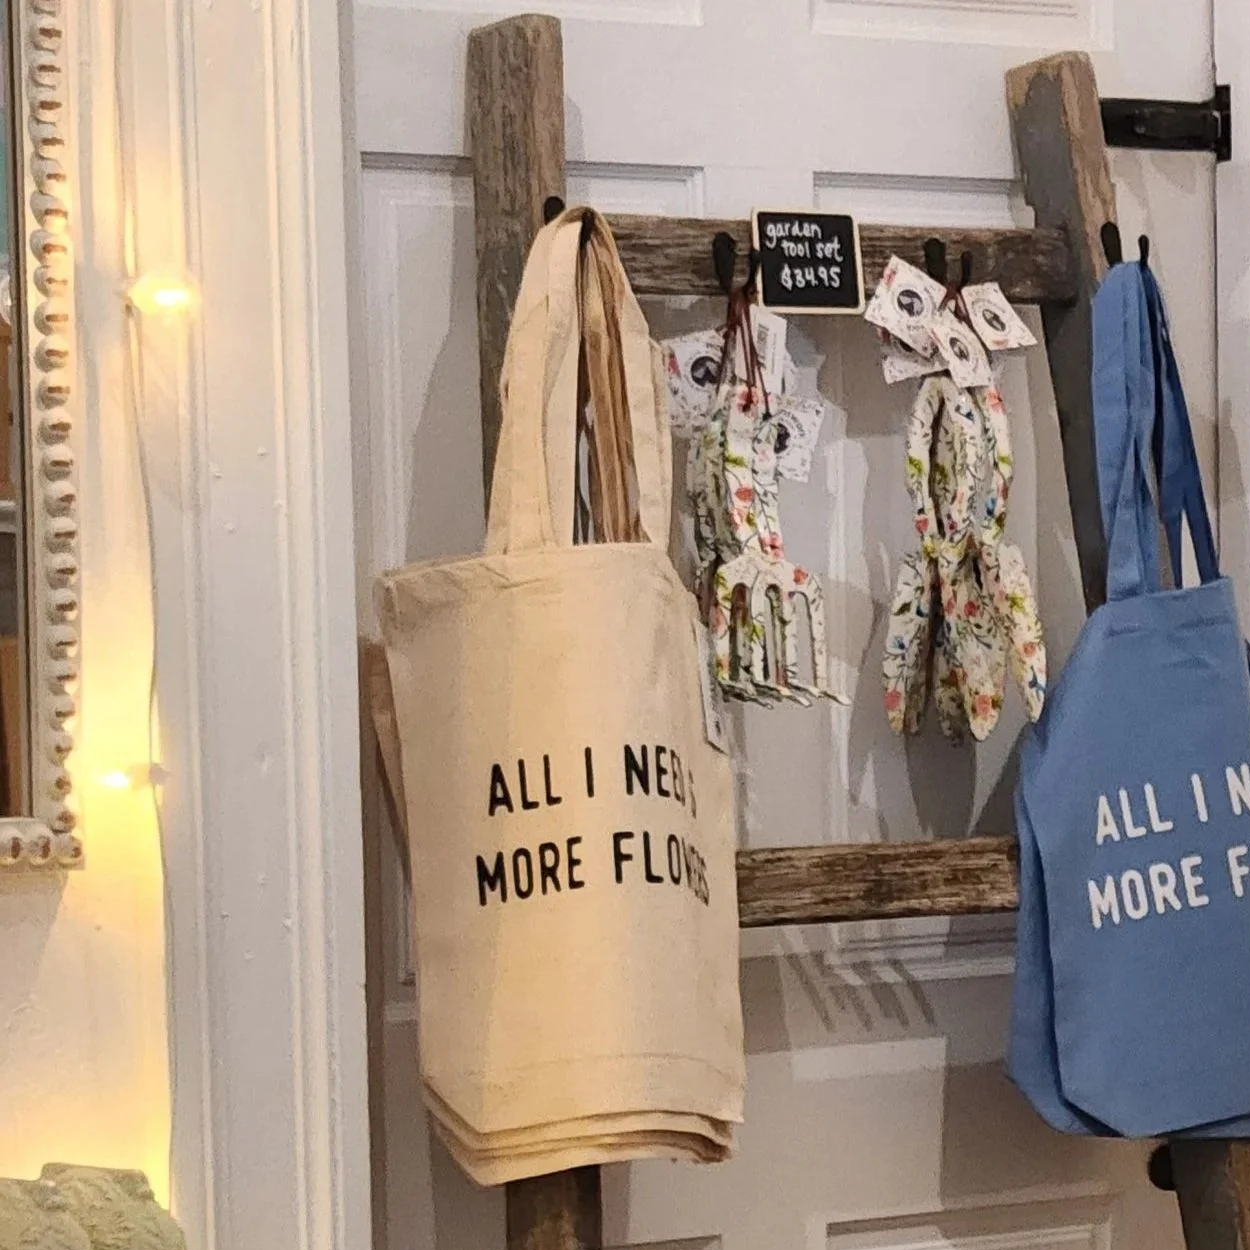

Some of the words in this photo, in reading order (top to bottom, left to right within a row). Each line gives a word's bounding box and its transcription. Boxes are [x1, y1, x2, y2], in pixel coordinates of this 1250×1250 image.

[765, 221, 822, 248] garden
[781, 240, 811, 258] tool
[815, 236, 843, 262] set
[488, 753, 562, 817] ALL
[584, 746, 595, 798] I
[1096, 782, 1174, 845] ALL
[1190, 773, 1209, 823] I
[476, 836, 585, 907] MORE
[1087, 855, 1210, 929] MORE
